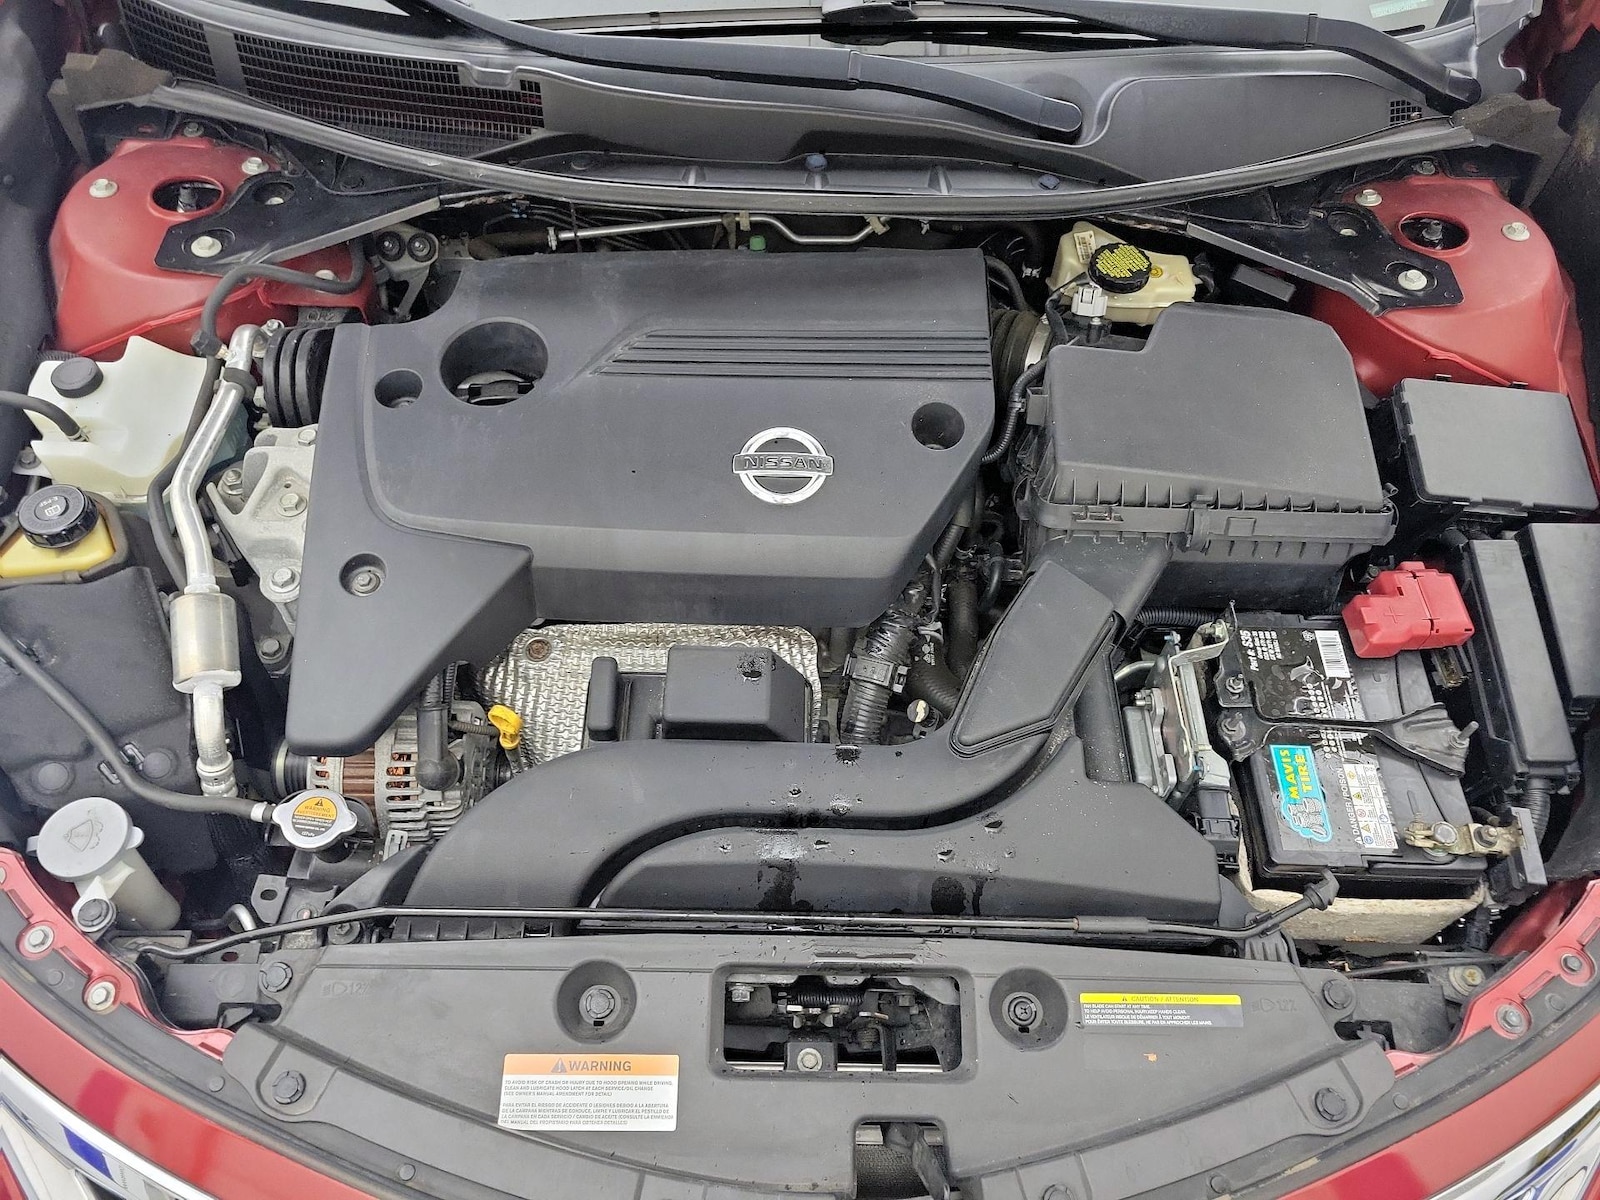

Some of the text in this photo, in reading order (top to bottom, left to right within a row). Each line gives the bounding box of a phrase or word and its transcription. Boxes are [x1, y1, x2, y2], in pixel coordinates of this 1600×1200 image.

[744, 456, 823, 470] NISSAN
[1240, 630, 1254, 648] S35
[1248, 656, 1259, 671] Part
[1280, 749, 1300, 799] MAVIS
[1295, 754, 1313, 792] TIRE
[569, 1060, 632, 1072] WARNING
